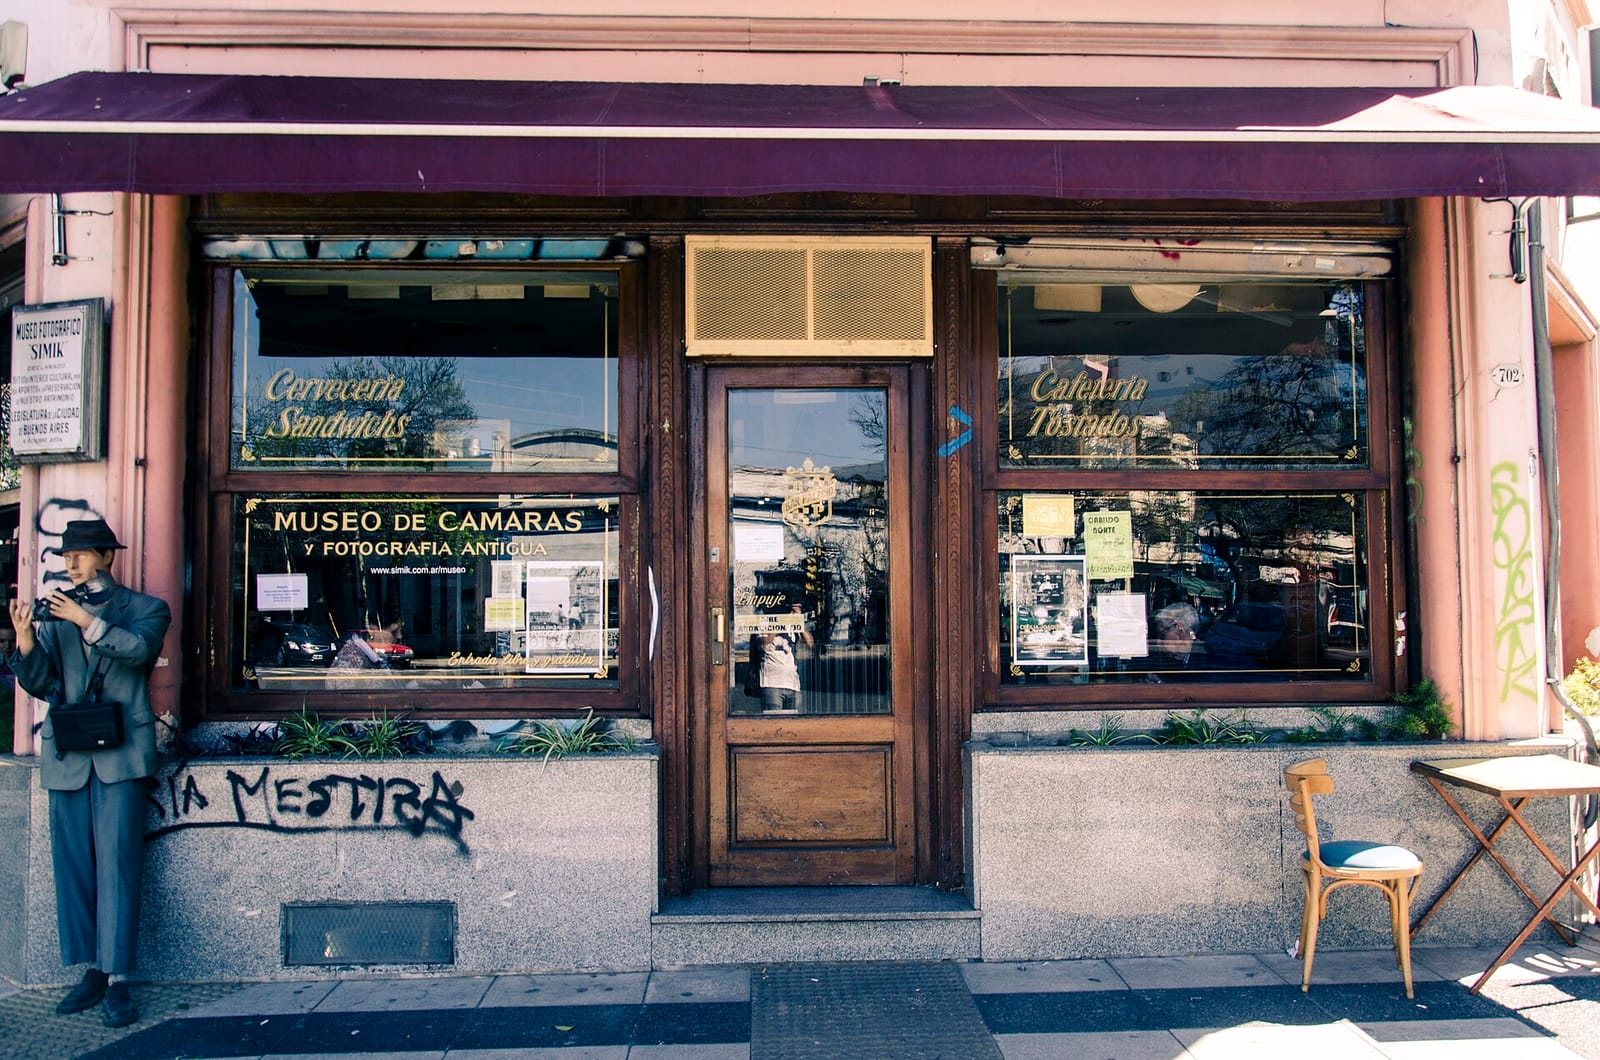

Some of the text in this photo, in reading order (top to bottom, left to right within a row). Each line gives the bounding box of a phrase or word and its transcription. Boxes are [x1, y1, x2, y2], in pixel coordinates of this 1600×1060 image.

[16, 317, 81, 340] MUSEO FOTOGRAFICO
[1499, 368, 1520, 383] 702
[23, 423, 48, 435] BUENOS
[50, 422, 69, 433] AIRES
[264, 406, 411, 439] Sandwichs
[1026, 405, 1143, 438] Tostados
[274, 511, 583, 532] MUSEO DE CAMARAS
[323, 542, 452, 556] FOTOGRAFIA
[461, 542, 548, 556] ANTIGUA
[370, 565, 466, 575] www.simik.com.ar/museo
[737, 591, 786, 608] Empuje
[447, 651, 498, 666] Entrada
[541, 654, 594, 668] gratuita
